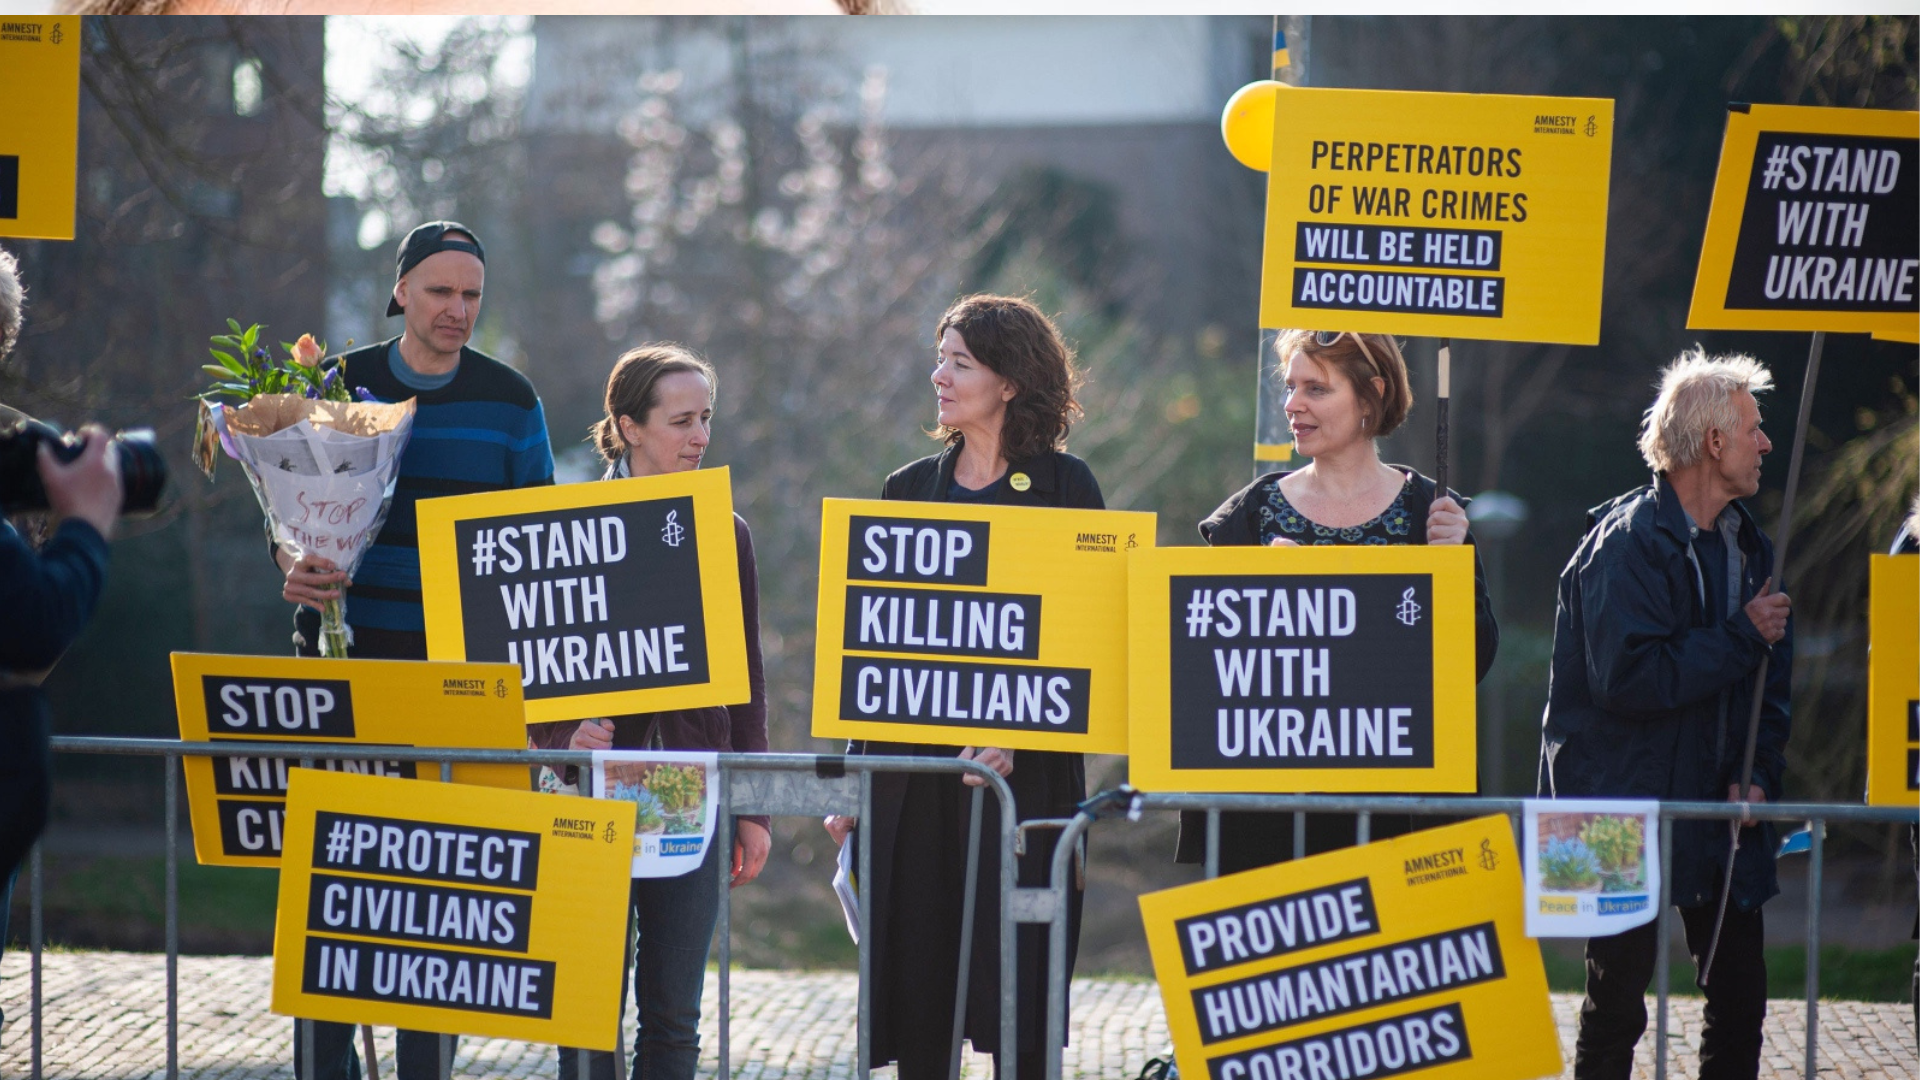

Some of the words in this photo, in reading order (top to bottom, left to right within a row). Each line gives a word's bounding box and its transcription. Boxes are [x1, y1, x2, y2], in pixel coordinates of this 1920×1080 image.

[1, 22, 42, 34] AMNESTY
[1534, 115, 1577, 126] AMNESTY
[1534, 126, 1576, 135] INTERNATIONAL
[1311, 140, 1522, 178] PERPETRATORS
[1762, 144, 1901, 194] #STAND
[1308, 184, 1343, 214] OF
[1352, 186, 1411, 217] WAR
[1422, 188, 1528, 223] CRIMES
[1777, 201, 1870, 247] WITH
[1304, 227, 1370, 260] WILL
[1378, 230, 1415, 262] BE
[1423, 233, 1494, 266] HELD
[1300, 271, 1498, 311] ACCOUNTABLE
[1764, 255, 1919, 302] UKRAINE
[295, 491, 368, 525] STOP
[287, 524, 330, 549] THE
[472, 516, 627, 576] #STAND
[862, 525, 973, 577] STOP
[1075, 544, 1117, 553] INTERNATIONAL
[1076, 533, 1117, 545] AMNESTY
[500, 575, 608, 630] WITH
[1186, 588, 1356, 638] #STAND
[859, 595, 1025, 651] KILLING
[508, 625, 689, 687] UKRAINE
[1214, 648, 1330, 697] WITH
[443, 679, 485, 689] AMNESTY
[443, 689, 487, 697] INTERNATIONAL
[856, 665, 1071, 725] CIVILIANS
[220, 684, 335, 729] STOP
[1218, 707, 1413, 757] UKRAINE
[552, 830, 594, 841] INTERNATIONAL
[553, 817, 596, 832] AMNESTY
[325, 820, 530, 882] #PROTECT
[645, 842, 656, 853] in
[1404, 848, 1465, 874] AMNESTY
[1406, 866, 1469, 887] INTERNATIONAL
[322, 883, 516, 944] CIVILIANS
[1188, 885, 1371, 968] PROVIDE
[1540, 901, 1578, 913] Peace
[1582, 902, 1593, 913] in
[318, 945, 358, 991] IN
[372, 950, 541, 1011] UKRAINE
[1203, 930, 1493, 1037] HUMANTARIAN
